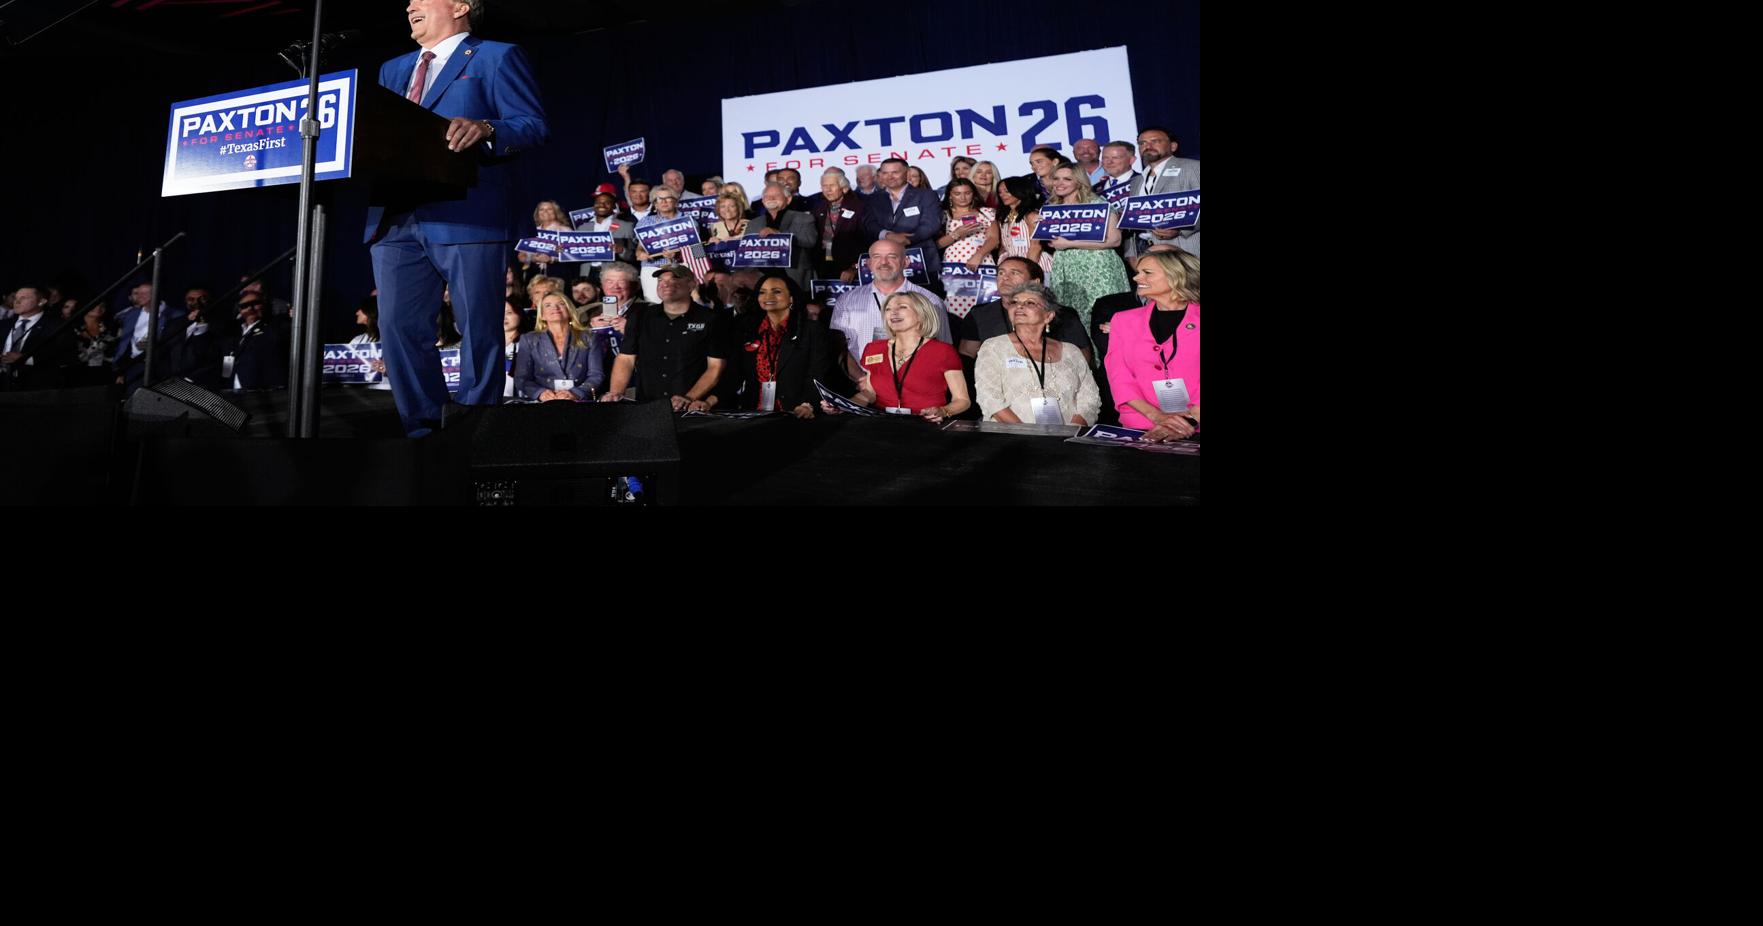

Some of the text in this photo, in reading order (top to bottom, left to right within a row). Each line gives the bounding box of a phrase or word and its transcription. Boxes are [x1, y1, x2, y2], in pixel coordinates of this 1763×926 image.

[182, 99, 297, 138] PAXTON
[741, 94, 1111, 159] PAXTON 26
[224, 125, 284, 142] SENATE
[219, 136, 287, 156] #TexasFirst
[765, 143, 982, 170] FOR SENATE
[1129, 194, 1200, 211] PAXTON
[1042, 209, 1107, 220] PAXTON
[1137, 210, 1187, 224] 2026
[639, 220, 693, 241] PAXTON
[1048, 223, 1092, 233] 2026
[560, 235, 612, 244] PAXTON
[651, 234, 689, 251] 2026
[739, 238, 790, 247] PAXTON
[528, 241, 556, 251] 202
[569, 246, 606, 254] 2026
[744, 250, 780, 259] 2026
[815, 285, 855, 293] PAXT
[324, 349, 382, 360] AXTON
